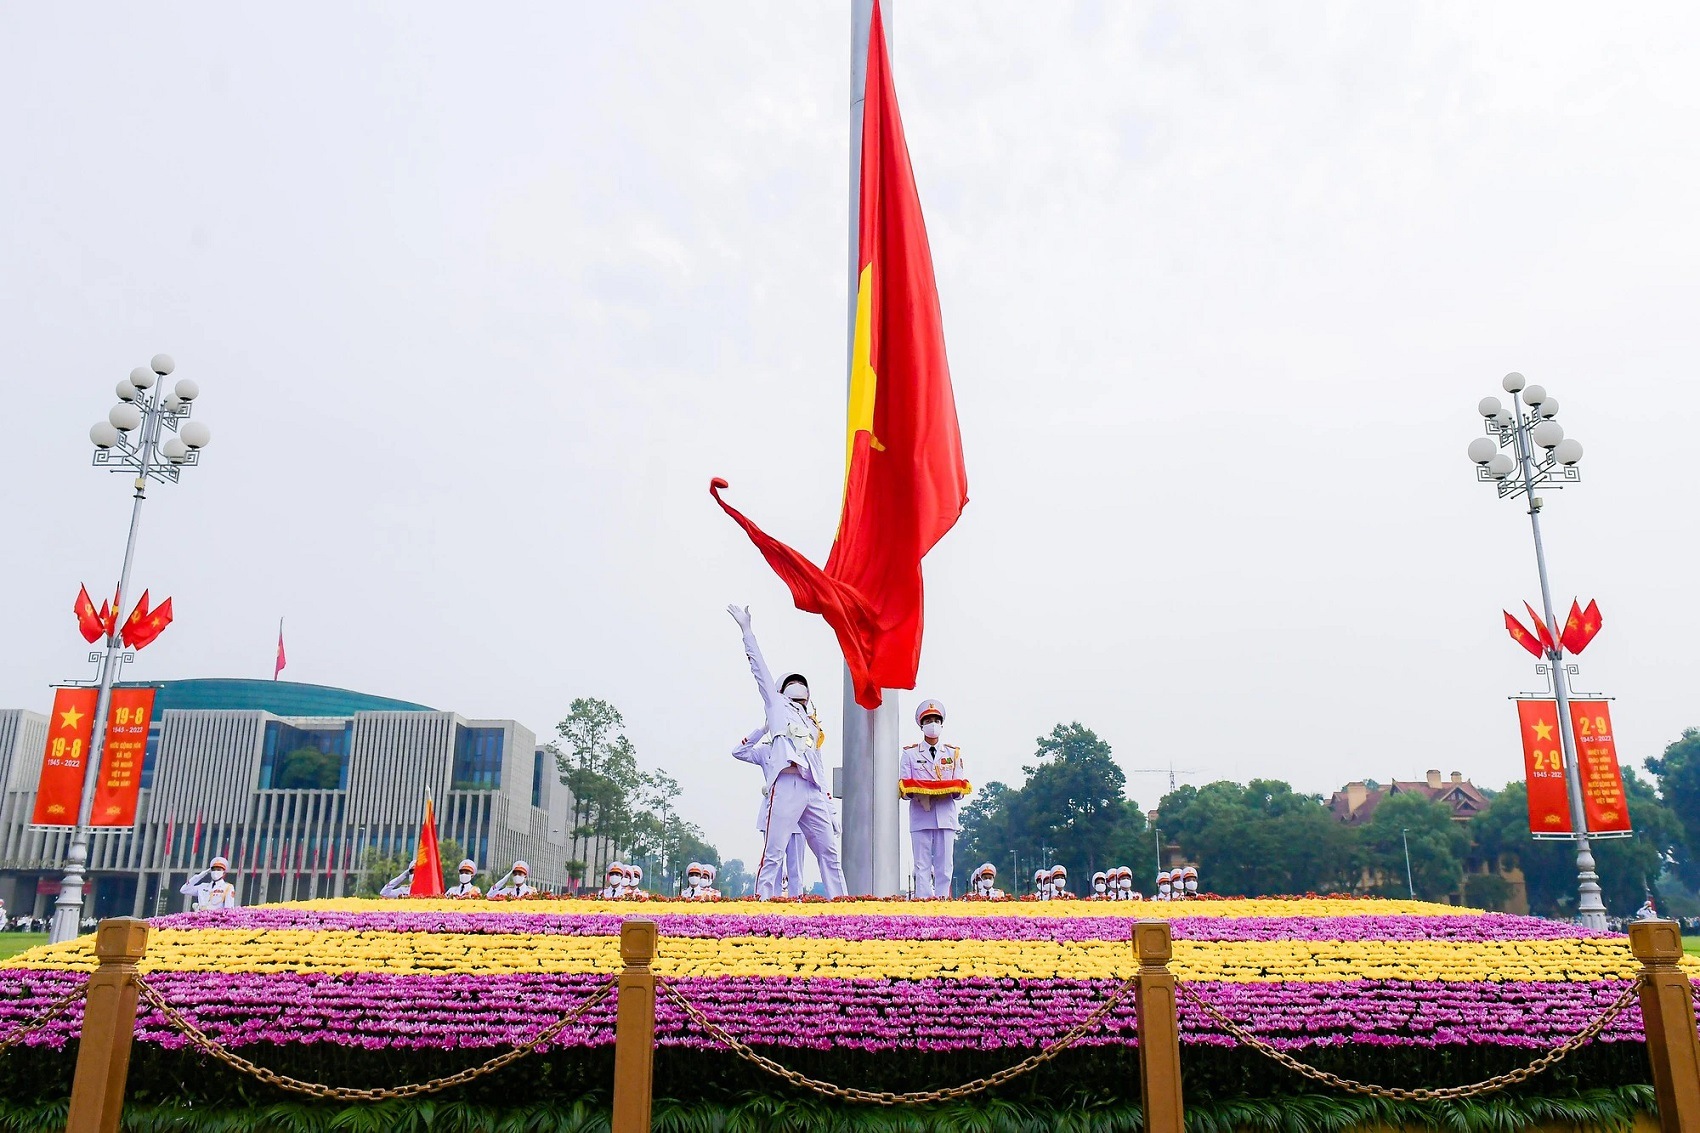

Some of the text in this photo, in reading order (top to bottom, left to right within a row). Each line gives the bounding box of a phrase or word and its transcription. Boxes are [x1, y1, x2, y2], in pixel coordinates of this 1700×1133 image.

[116, 707, 144, 724] 19-8
[1580, 717, 1606, 735] 2-9
[52, 738, 82, 758] 19-8
[1533, 750, 1560, 770] 2-9
